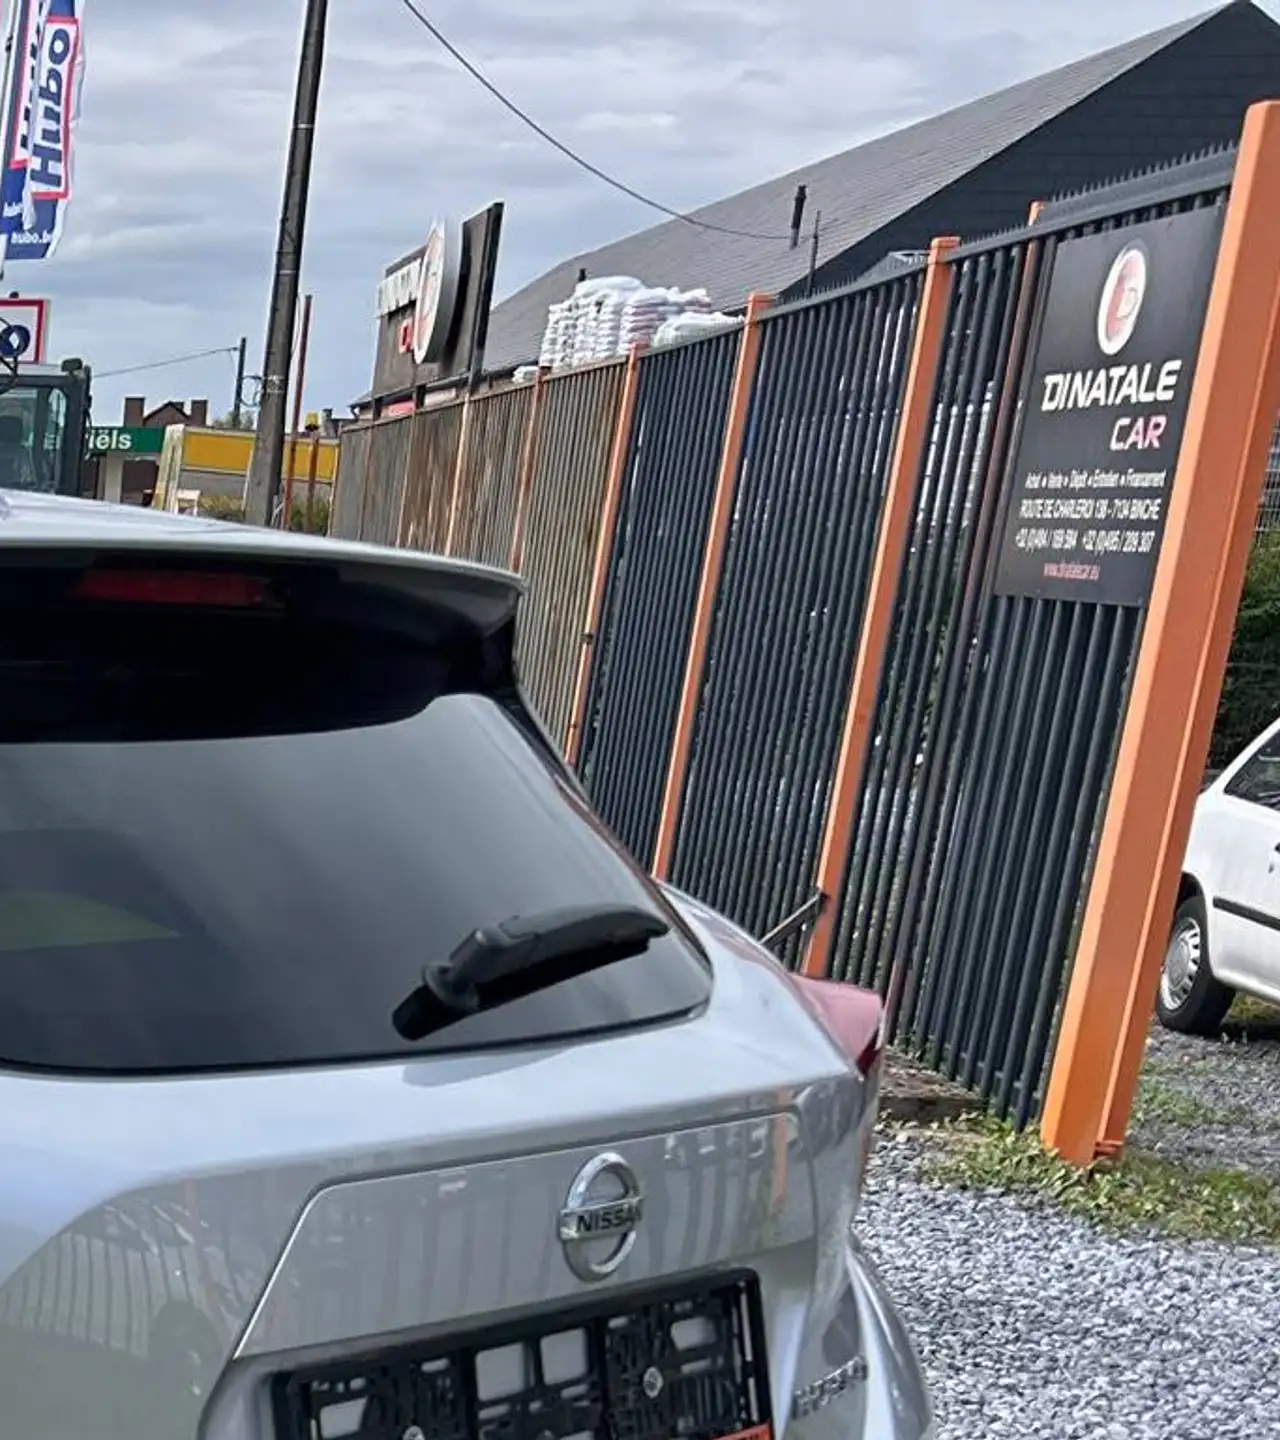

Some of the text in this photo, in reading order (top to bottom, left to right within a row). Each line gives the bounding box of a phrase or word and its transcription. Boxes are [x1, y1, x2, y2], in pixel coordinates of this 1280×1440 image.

[30, 28, 70, 188] Hubo
[1041, 360, 1182, 412] DINATALE
[1109, 415, 1167, 451] CAR
